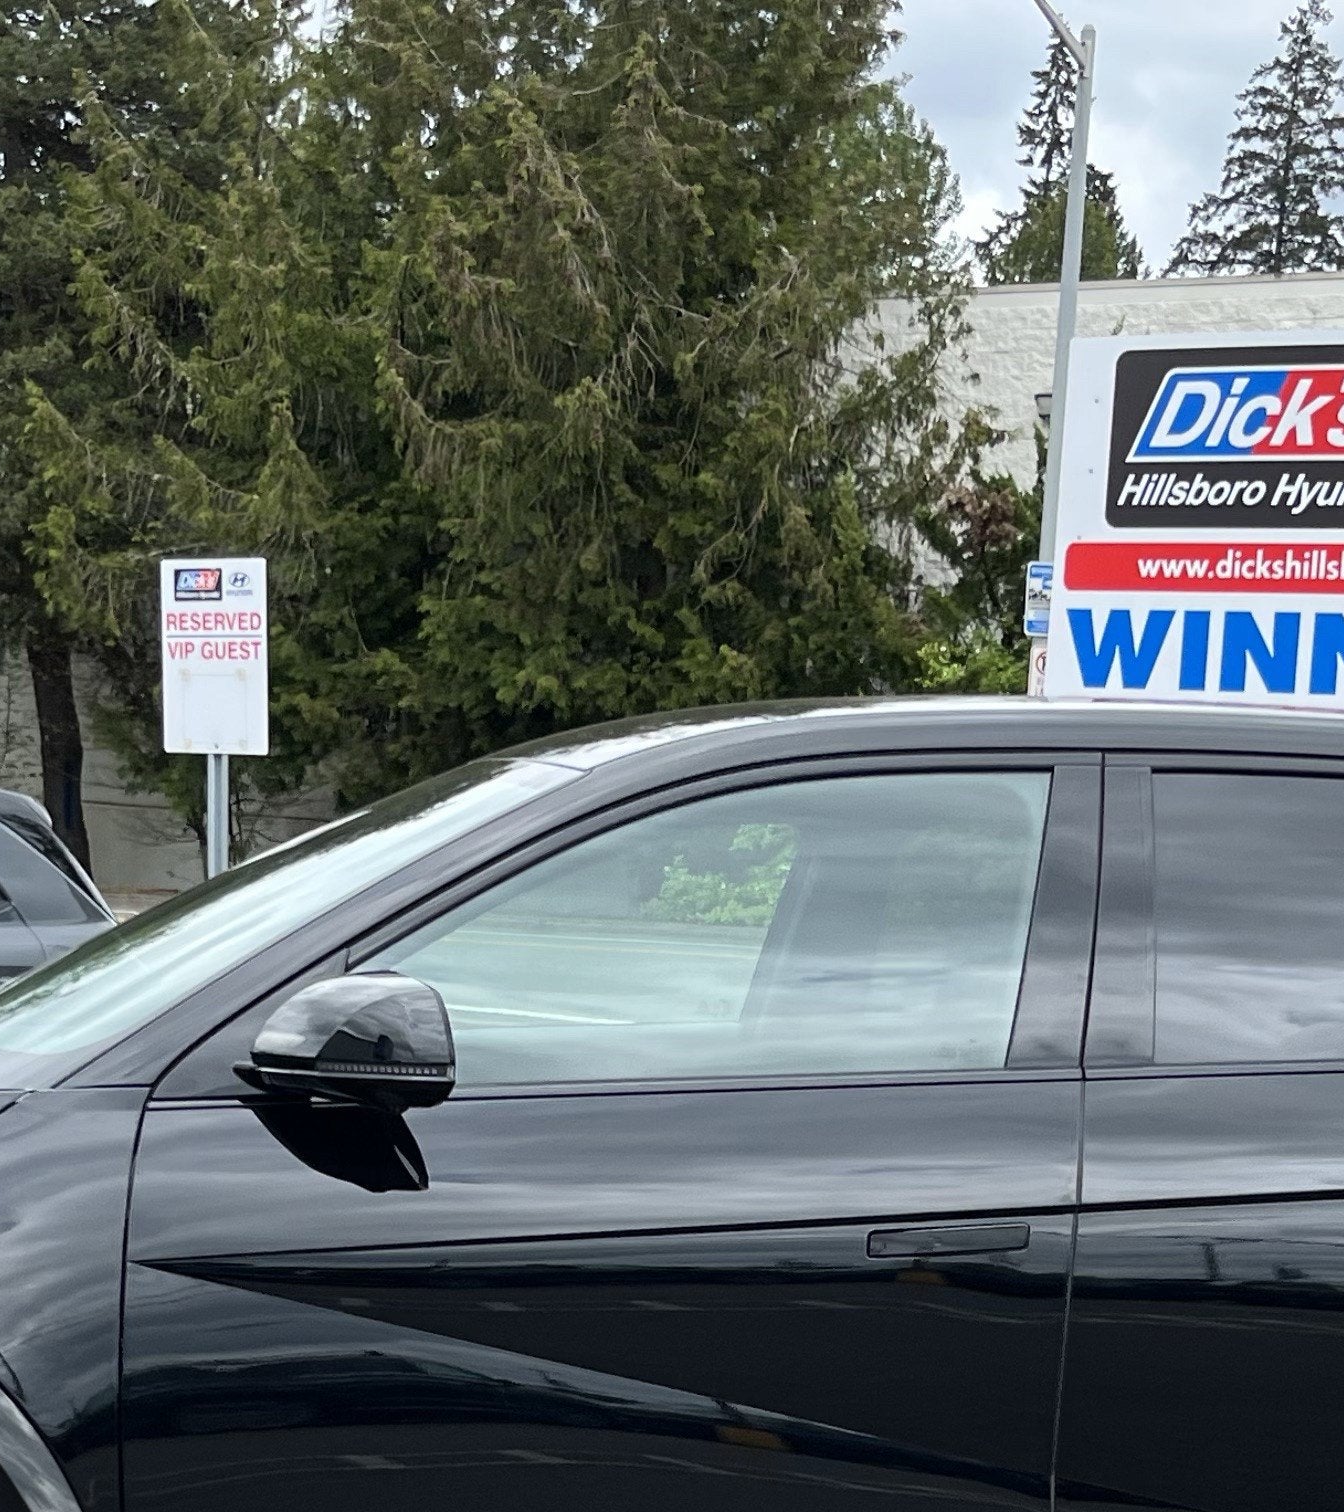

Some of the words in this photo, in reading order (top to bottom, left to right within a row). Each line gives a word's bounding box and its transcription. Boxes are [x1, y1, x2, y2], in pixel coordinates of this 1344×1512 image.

[1117, 472, 1268, 506] Hillsboro
[166, 612, 261, 631] RESERVED
[167, 641, 194, 660] VIP
[200, 641, 261, 661] GUEST
